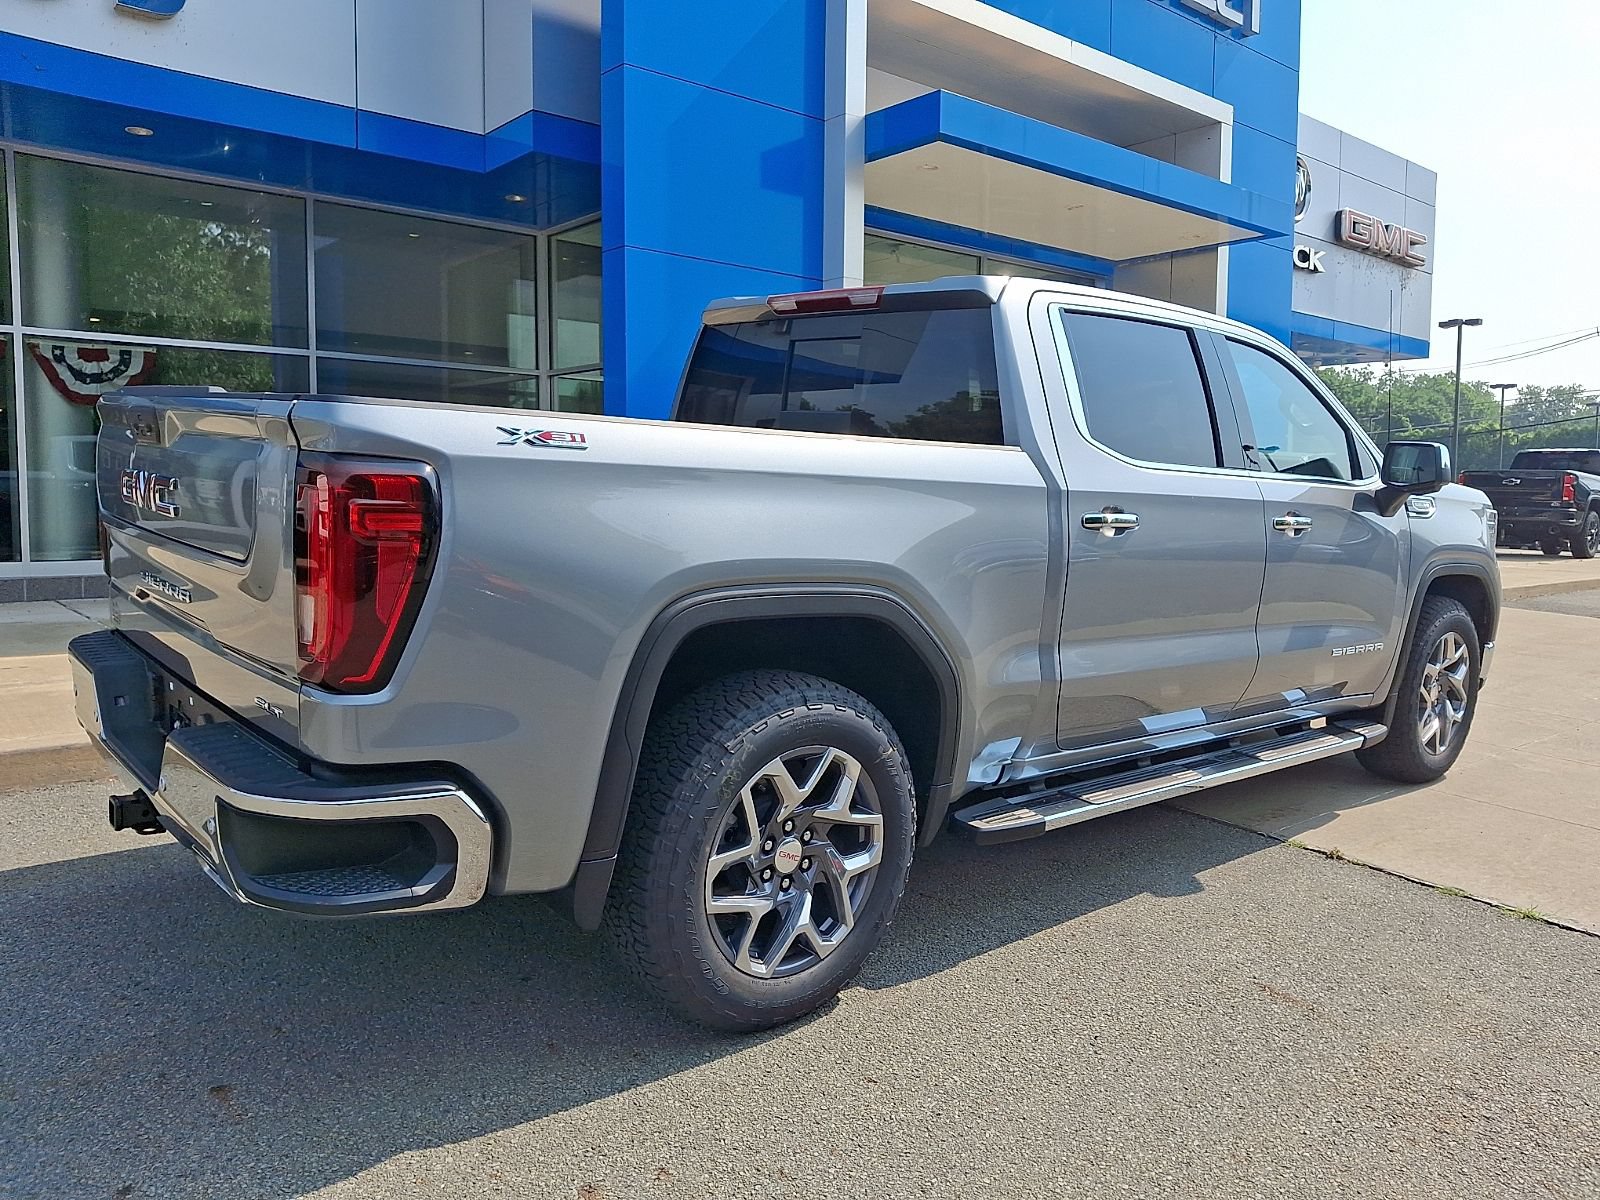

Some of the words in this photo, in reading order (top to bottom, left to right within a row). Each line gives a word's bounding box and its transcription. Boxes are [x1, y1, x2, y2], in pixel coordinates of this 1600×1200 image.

[1339, 208, 1427, 267] GMC
[121, 469, 180, 518] GMC
[140, 570, 192, 603] SIERRA
[1331, 642, 1384, 657] SIERRA
[254, 696, 284, 718] SLT
[778, 850, 800, 862] GMC
